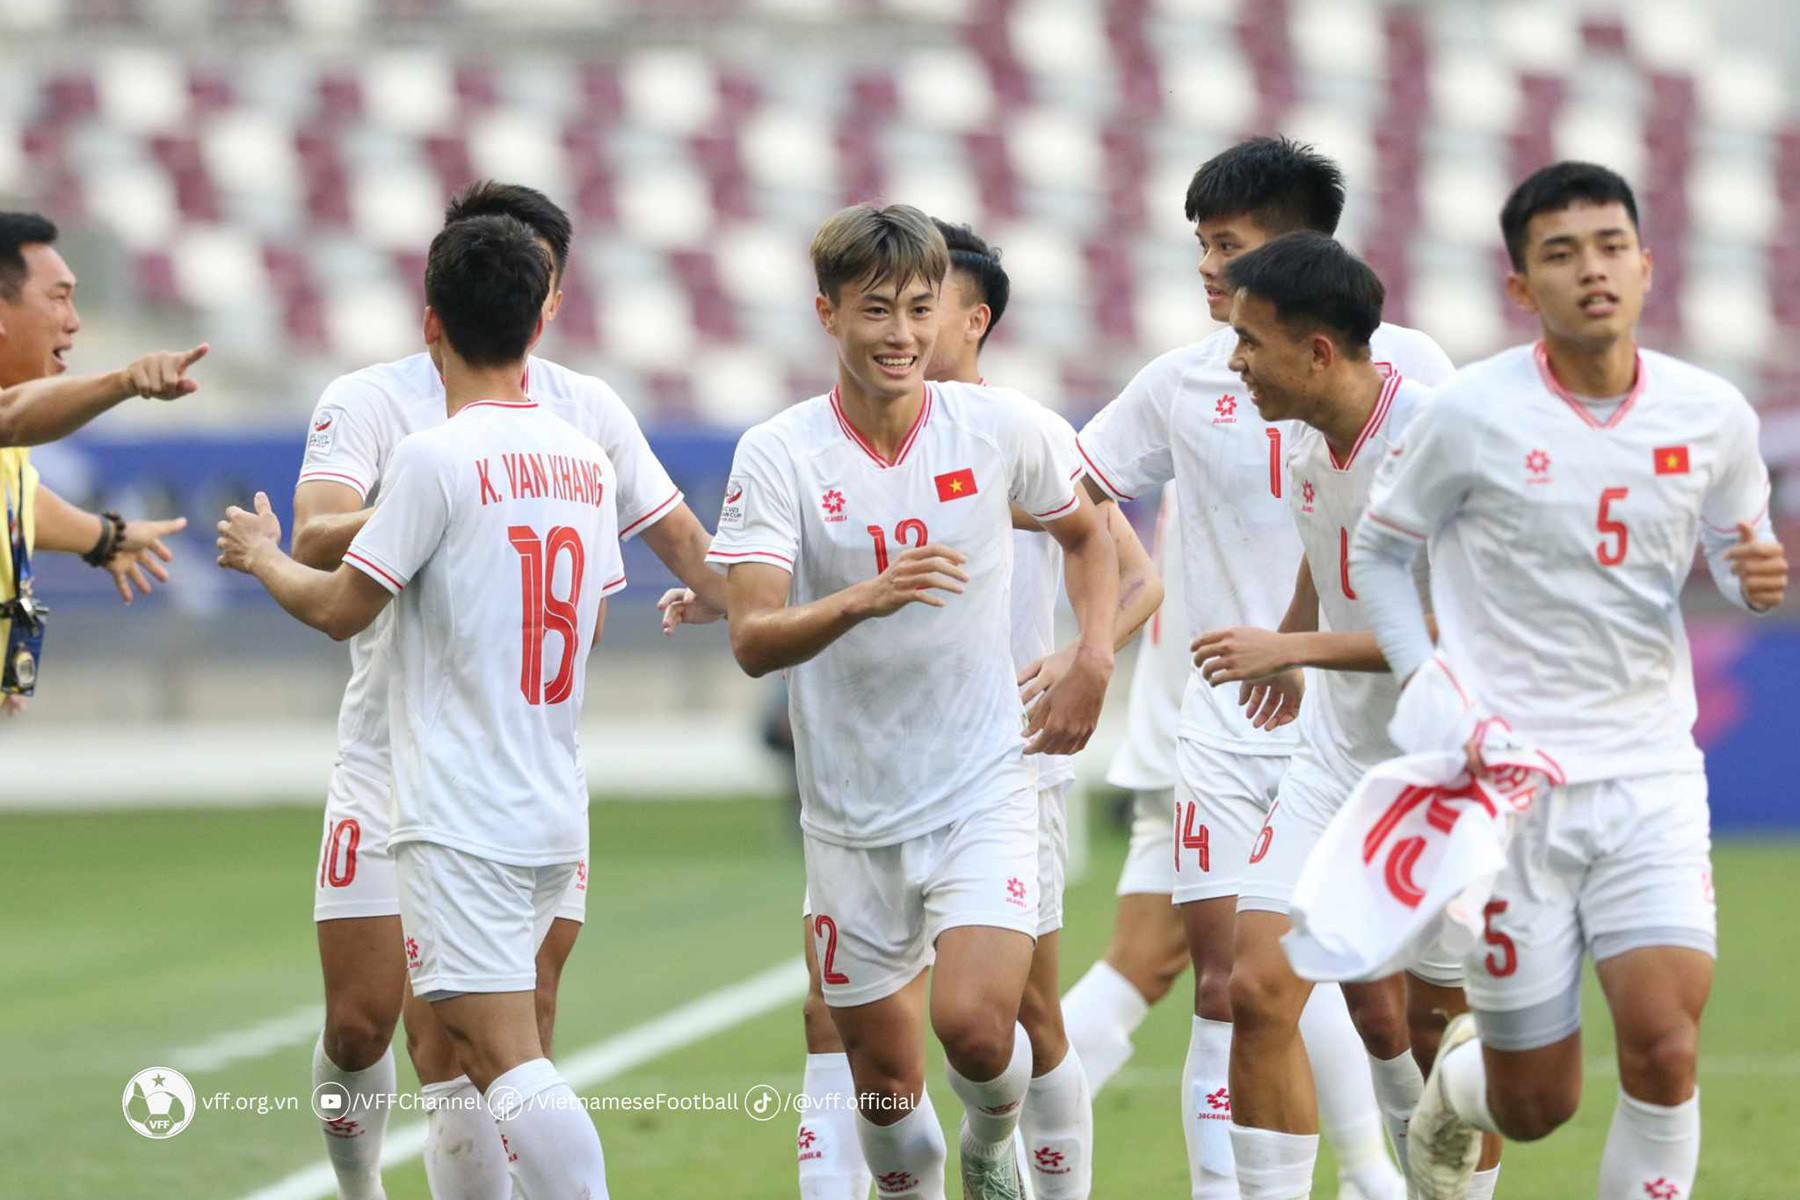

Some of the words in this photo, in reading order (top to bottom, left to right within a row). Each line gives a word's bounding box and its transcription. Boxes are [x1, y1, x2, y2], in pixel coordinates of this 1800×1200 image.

[475, 458, 503, 506] K.
[502, 453, 549, 499] VAN
[548, 454, 603, 508] KHANG
[1597, 487, 1629, 568] 5
[507, 525, 585, 705] 18
[321, 819, 361, 888] 10
[1174, 801, 1210, 872] 14
[1484, 900, 1518, 978] 5
